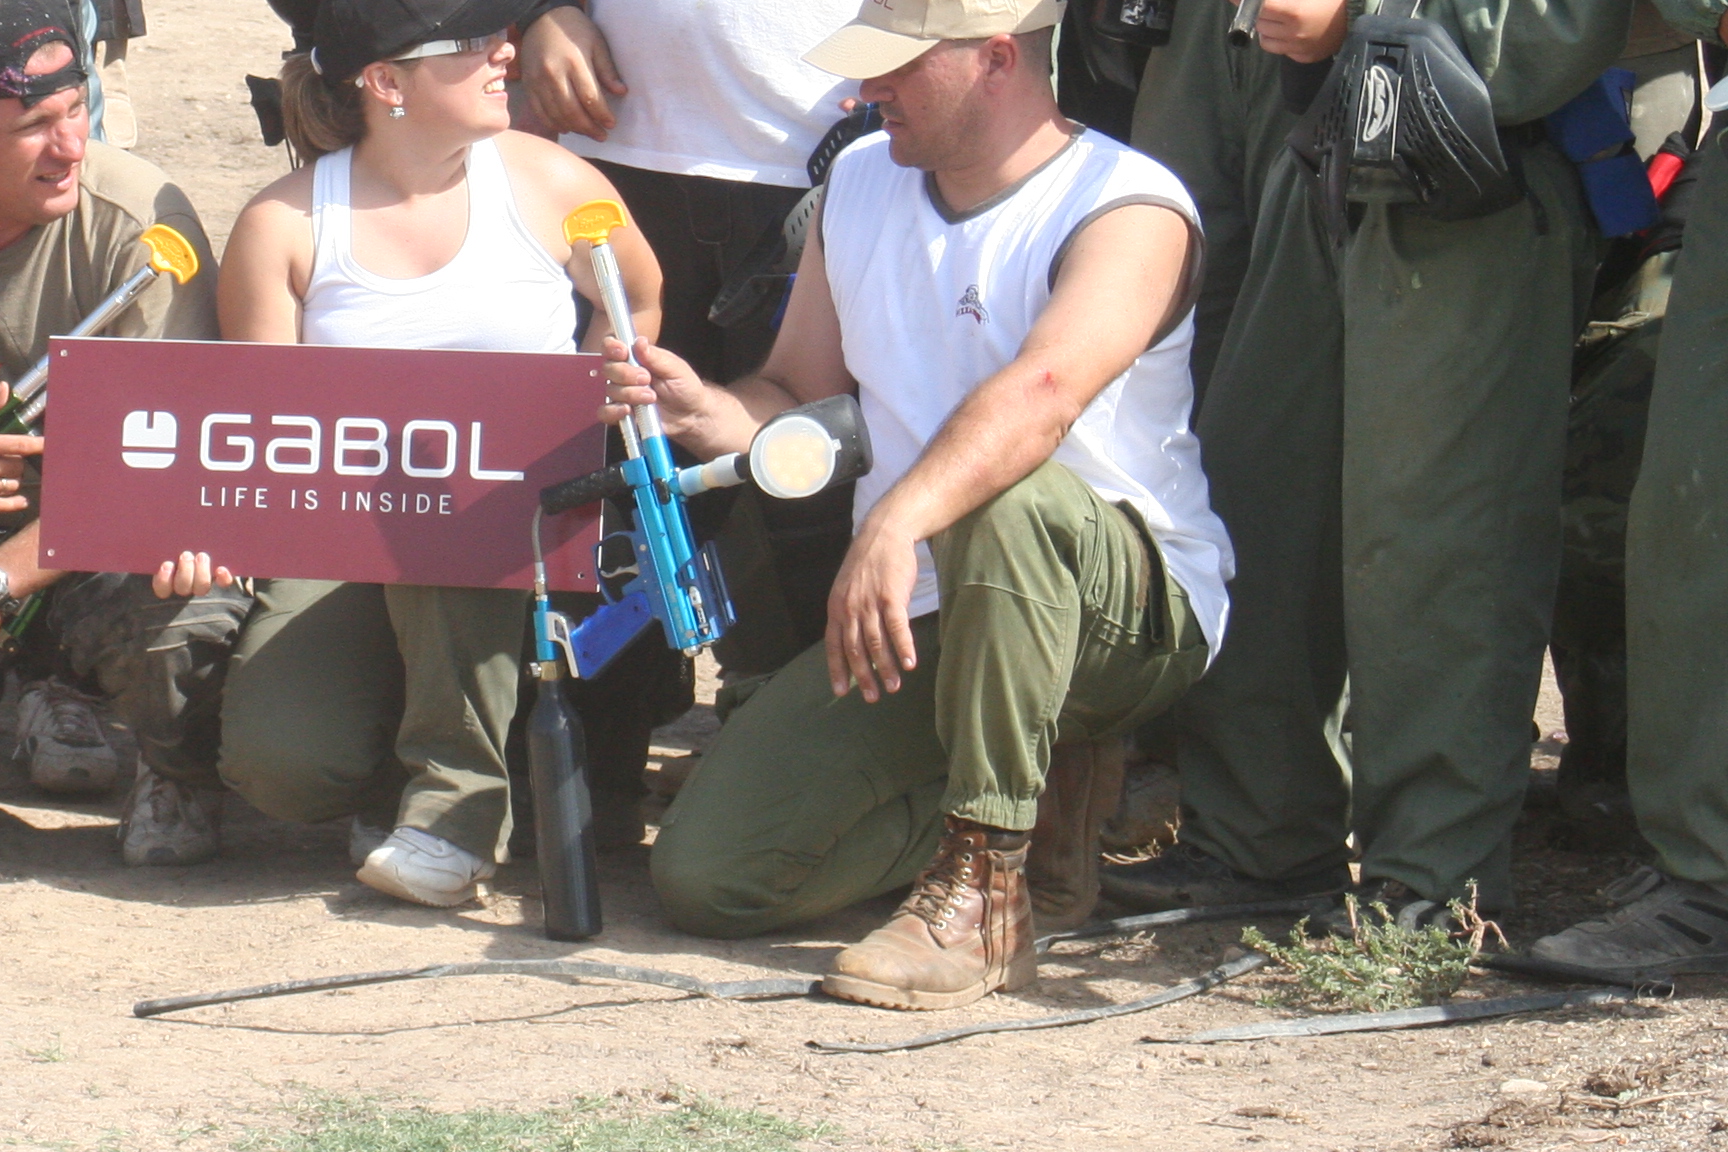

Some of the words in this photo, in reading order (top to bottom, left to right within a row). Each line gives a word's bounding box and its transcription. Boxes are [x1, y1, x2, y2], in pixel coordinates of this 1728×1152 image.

[199, 485, 269, 509] LIFE
[289, 488, 320, 512] IS
[340, 490, 453, 516] INSIDE
